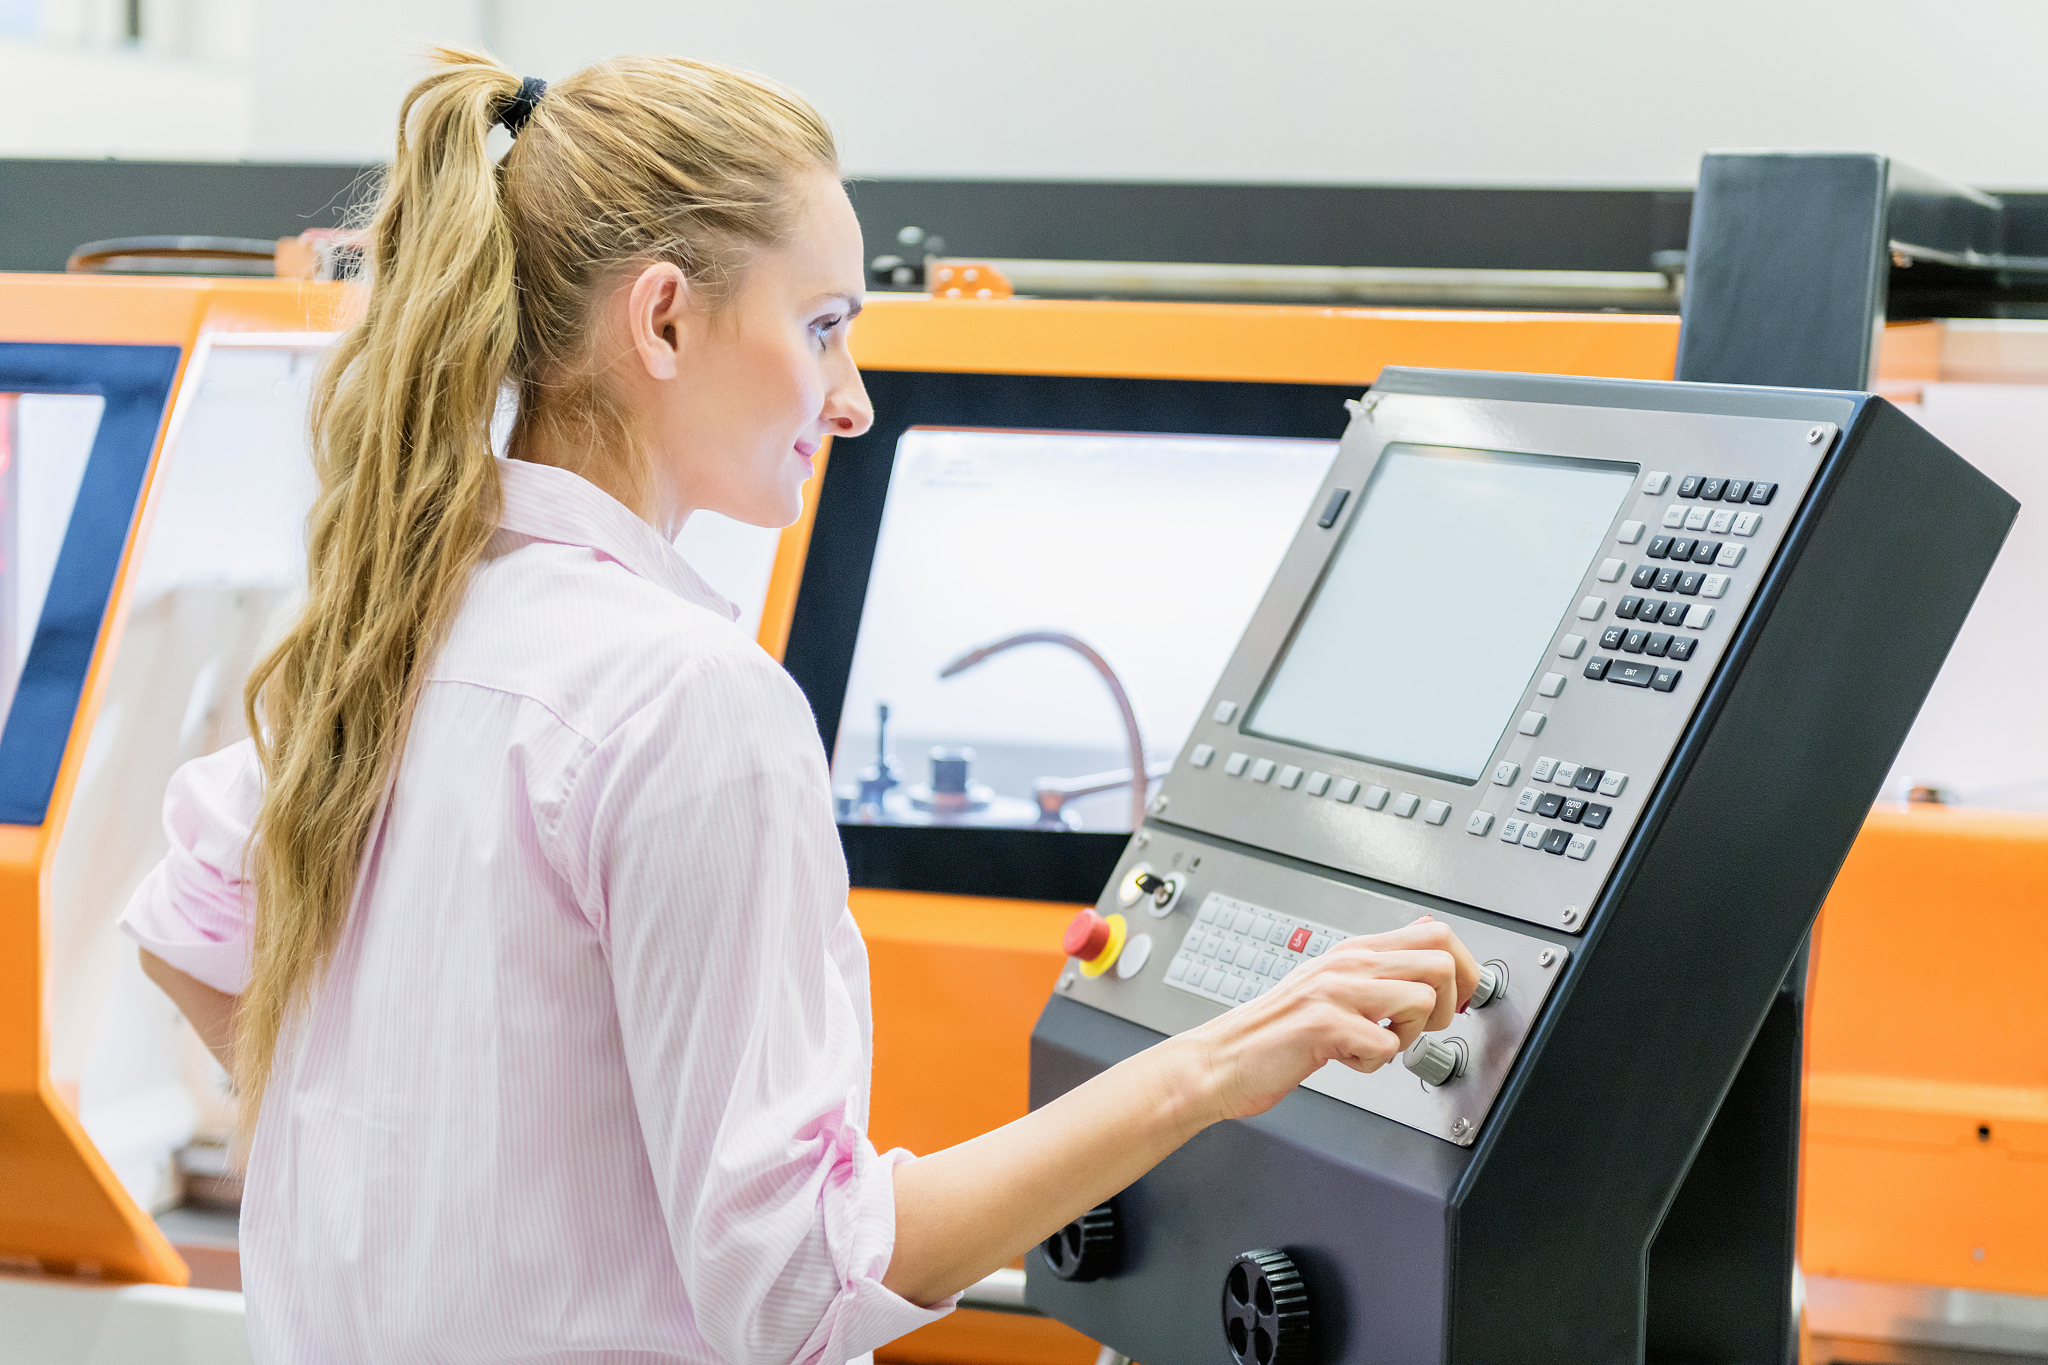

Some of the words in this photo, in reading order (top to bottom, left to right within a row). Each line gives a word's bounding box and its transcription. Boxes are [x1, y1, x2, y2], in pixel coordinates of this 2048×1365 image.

[1690, 513, 1704, 521] CALC
[1654, 540, 1663, 550] 7
[1677, 543, 1685, 552] 8
[1701, 546, 1708, 555] 9
[1639, 570, 1646, 580] 4
[1662, 574, 1669, 583] 5
[1685, 577, 1692, 586] 6
[1625, 600, 1631, 610] 1
[1645, 604, 1653, 614] 2
[1669, 608, 1676, 617] 3
[1605, 631, 1618, 641] CE
[1631, 635, 1637, 644] 0
[1590, 662, 1601, 670] ESC
[1556, 769, 1572, 777] HOME
[1566, 800, 1581, 808] GOTO
